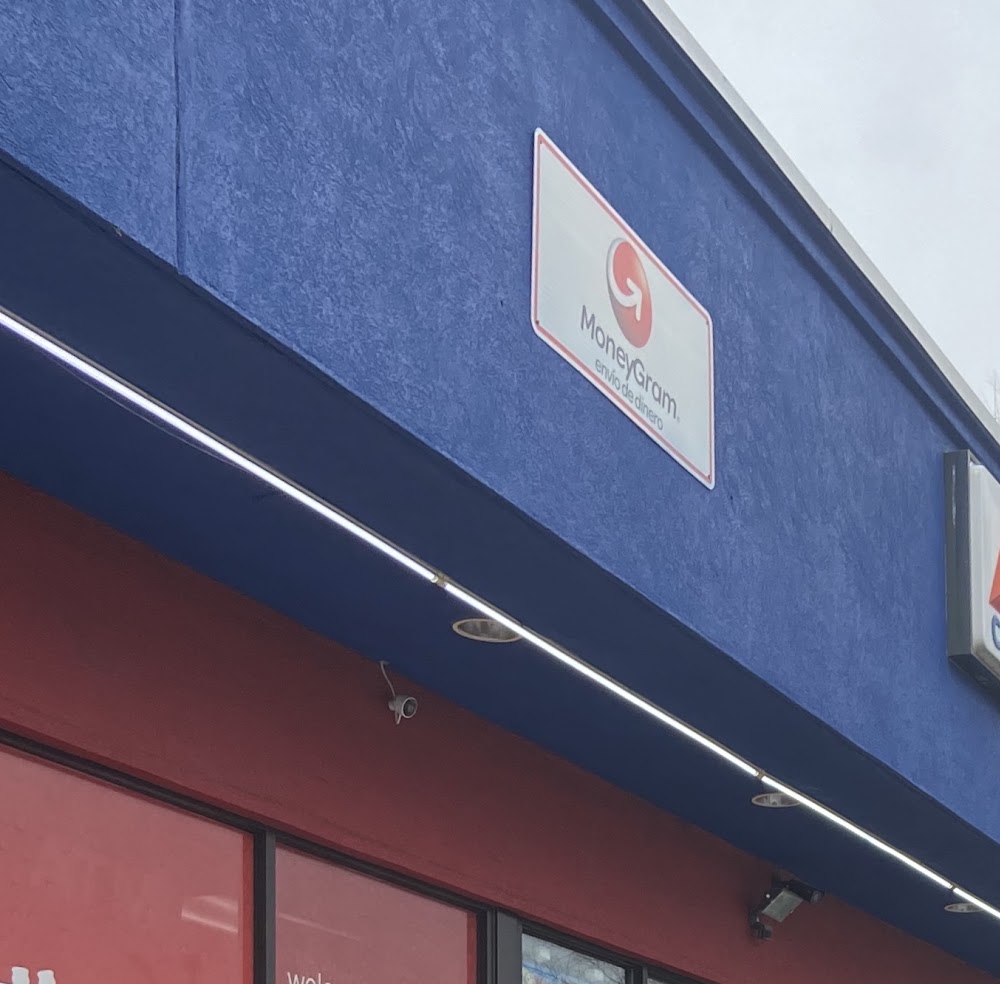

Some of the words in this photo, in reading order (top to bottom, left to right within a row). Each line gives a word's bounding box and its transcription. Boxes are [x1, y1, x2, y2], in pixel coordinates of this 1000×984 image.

[580, 304, 677, 419] MoneyGram
[621, 383, 634, 404] de
[634, 393, 664, 431] dinero
